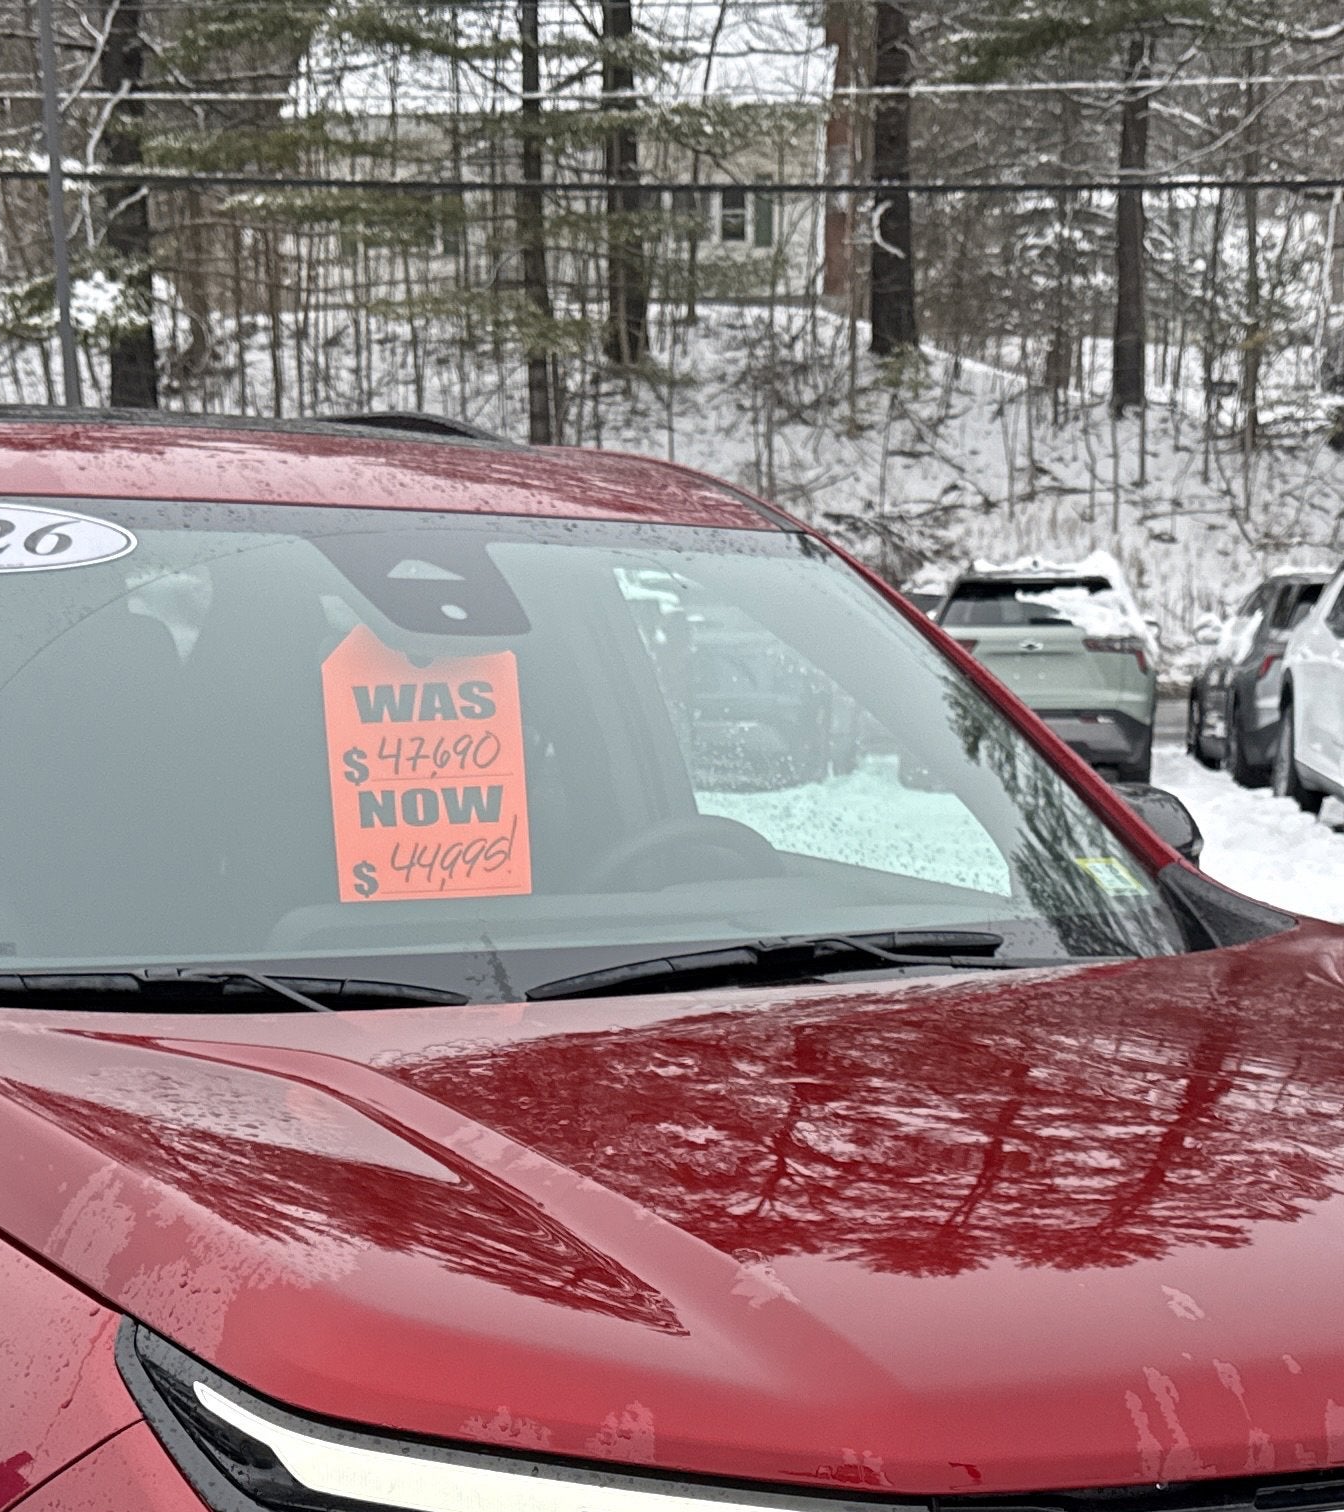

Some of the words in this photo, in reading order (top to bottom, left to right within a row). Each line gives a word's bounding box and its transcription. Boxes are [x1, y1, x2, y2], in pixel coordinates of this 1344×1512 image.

[352, 681, 497, 724] WAS
[343, 747, 370, 786] $
[358, 785, 504, 829] NOW
[353, 861, 379, 898] $
